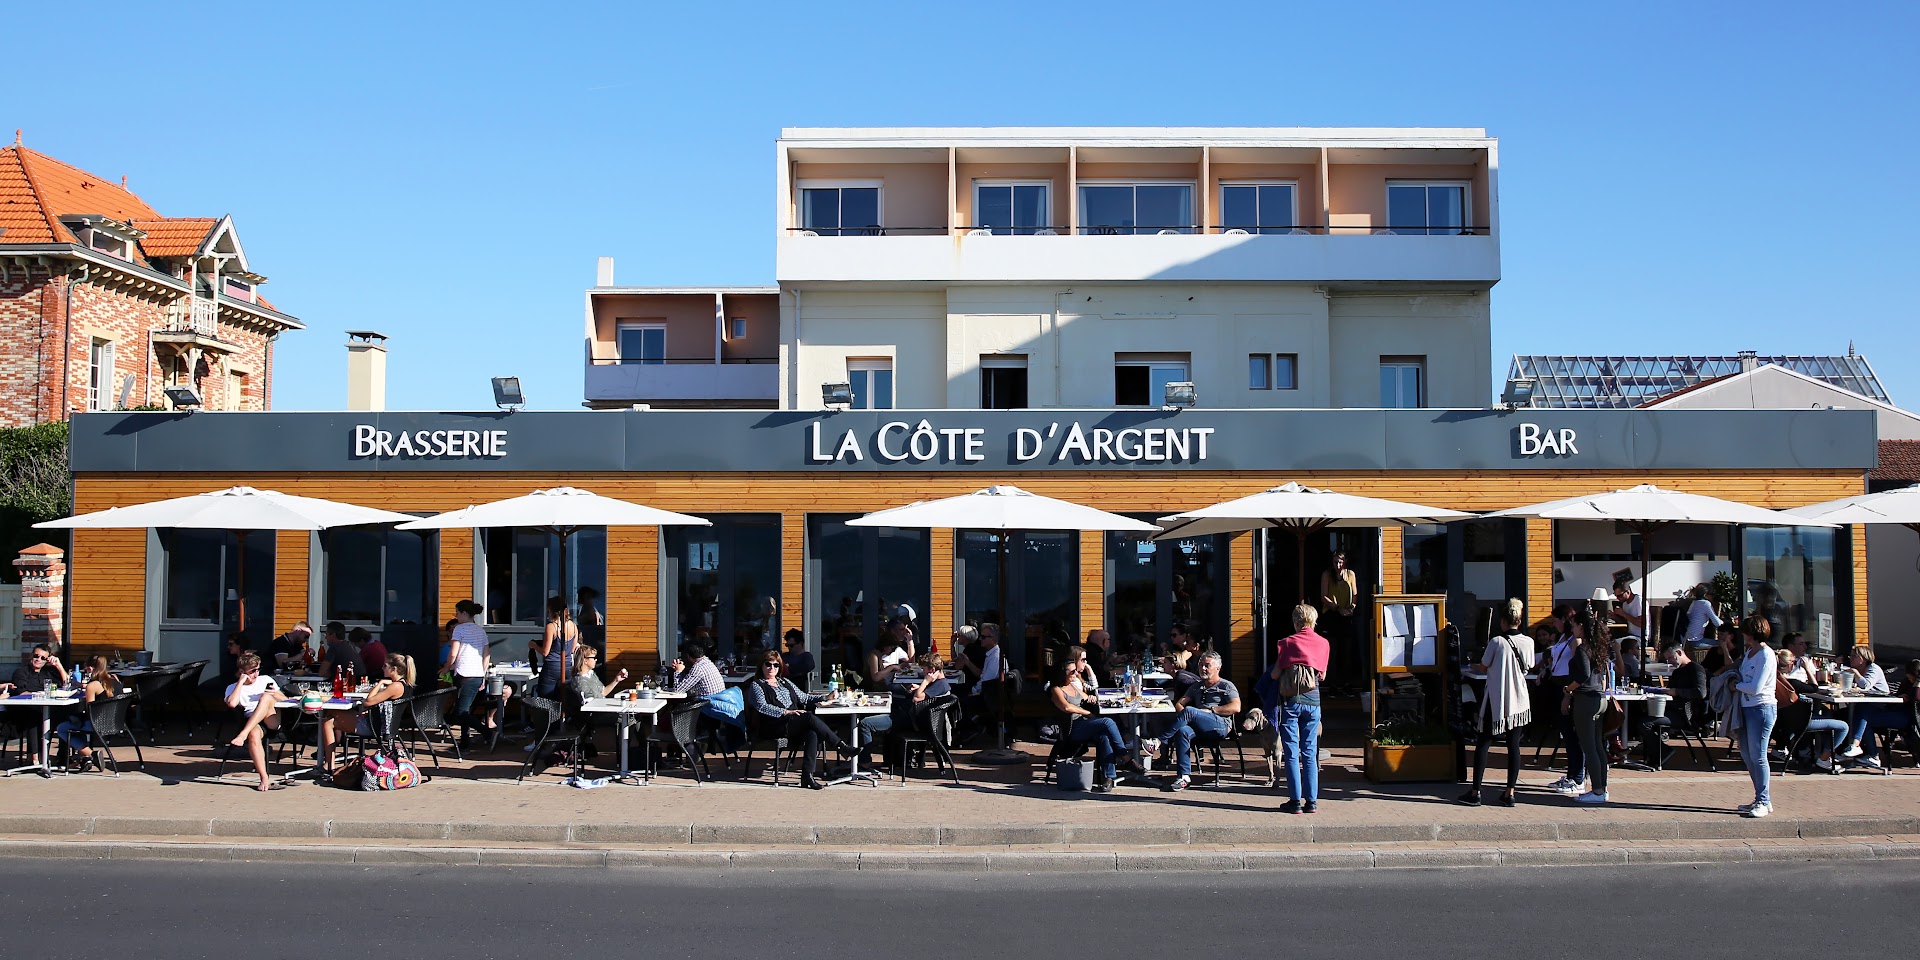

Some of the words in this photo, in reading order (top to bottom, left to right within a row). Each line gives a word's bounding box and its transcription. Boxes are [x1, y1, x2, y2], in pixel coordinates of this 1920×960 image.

[355, 424, 508, 456] BRASSERIE
[812, 421, 864, 461] LA
[877, 418, 985, 461] CÔTE
[1519, 423, 1579, 455] BAR
